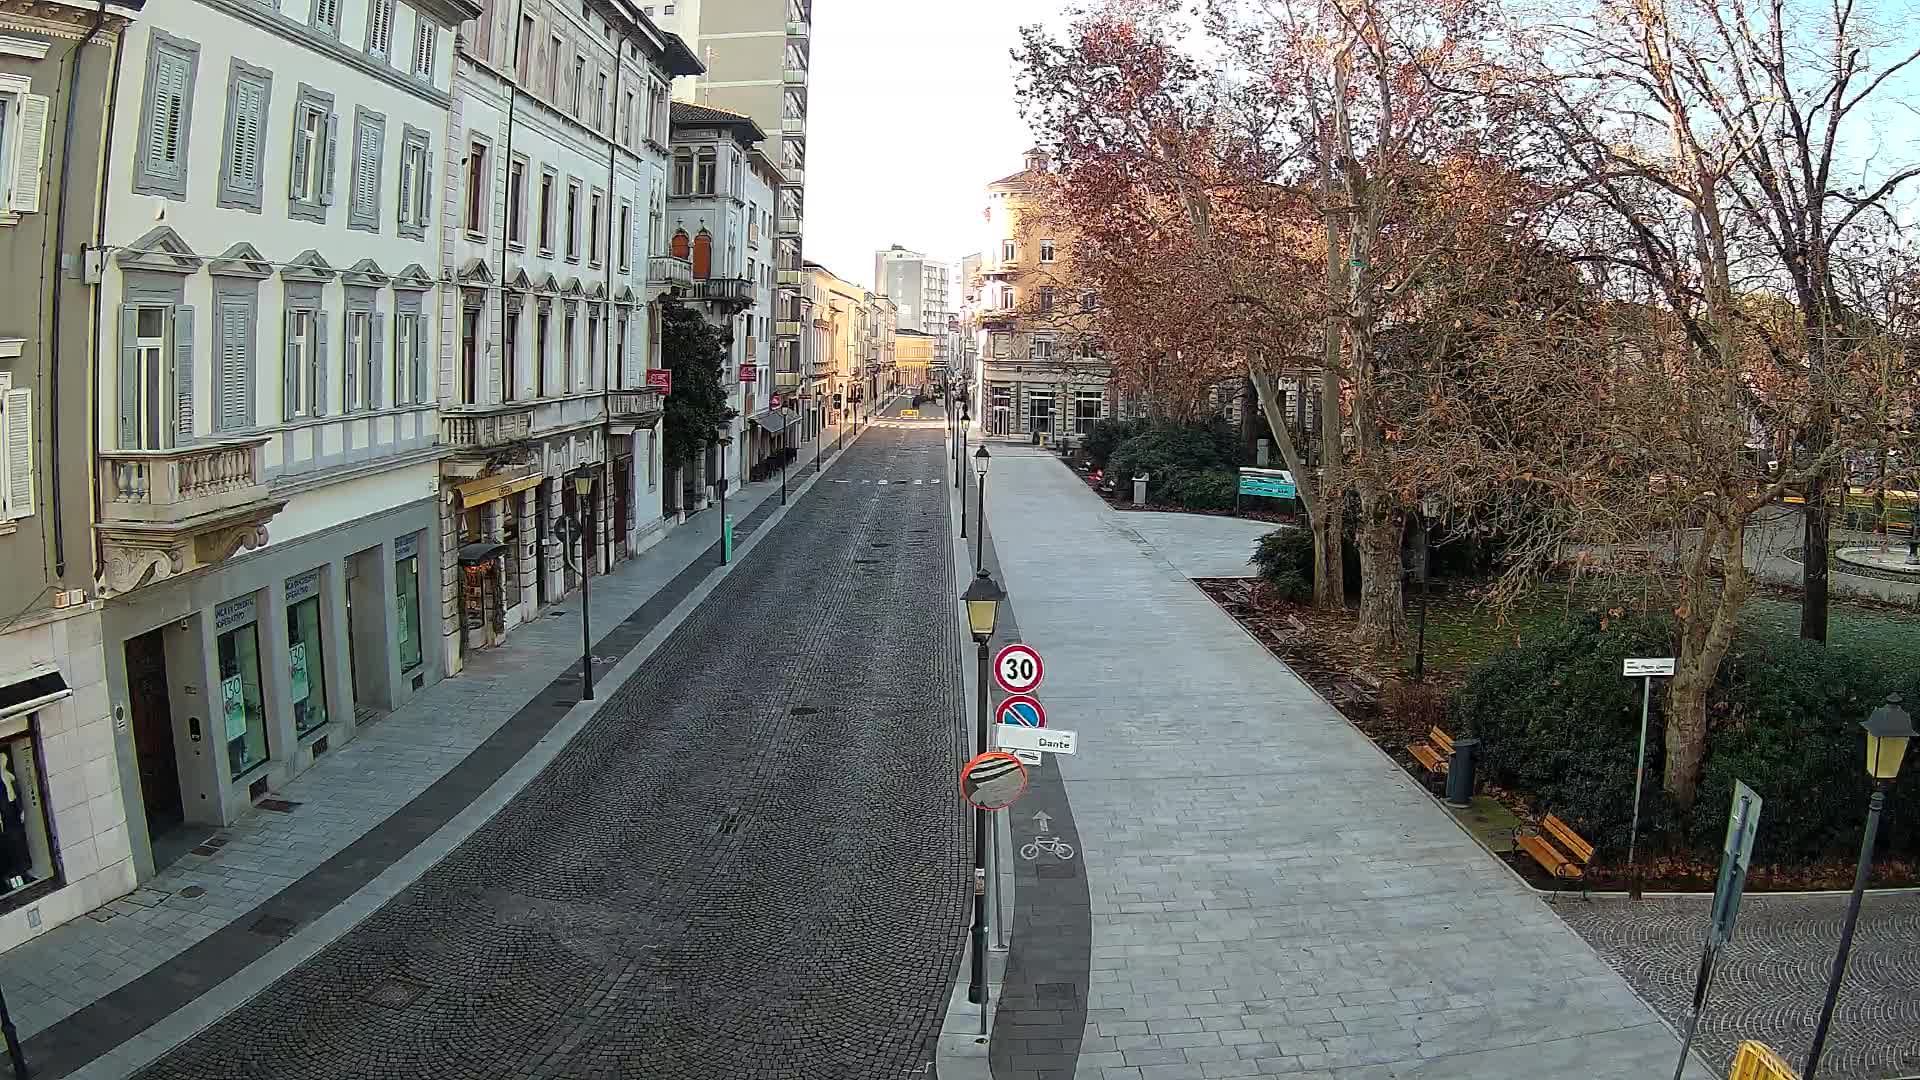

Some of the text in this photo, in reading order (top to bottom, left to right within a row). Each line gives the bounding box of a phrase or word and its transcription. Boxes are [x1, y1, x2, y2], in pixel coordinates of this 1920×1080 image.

[1006, 658, 1034, 681] 30
[223, 677, 241, 700] 130
[1039, 737, 1070, 749] Dante
